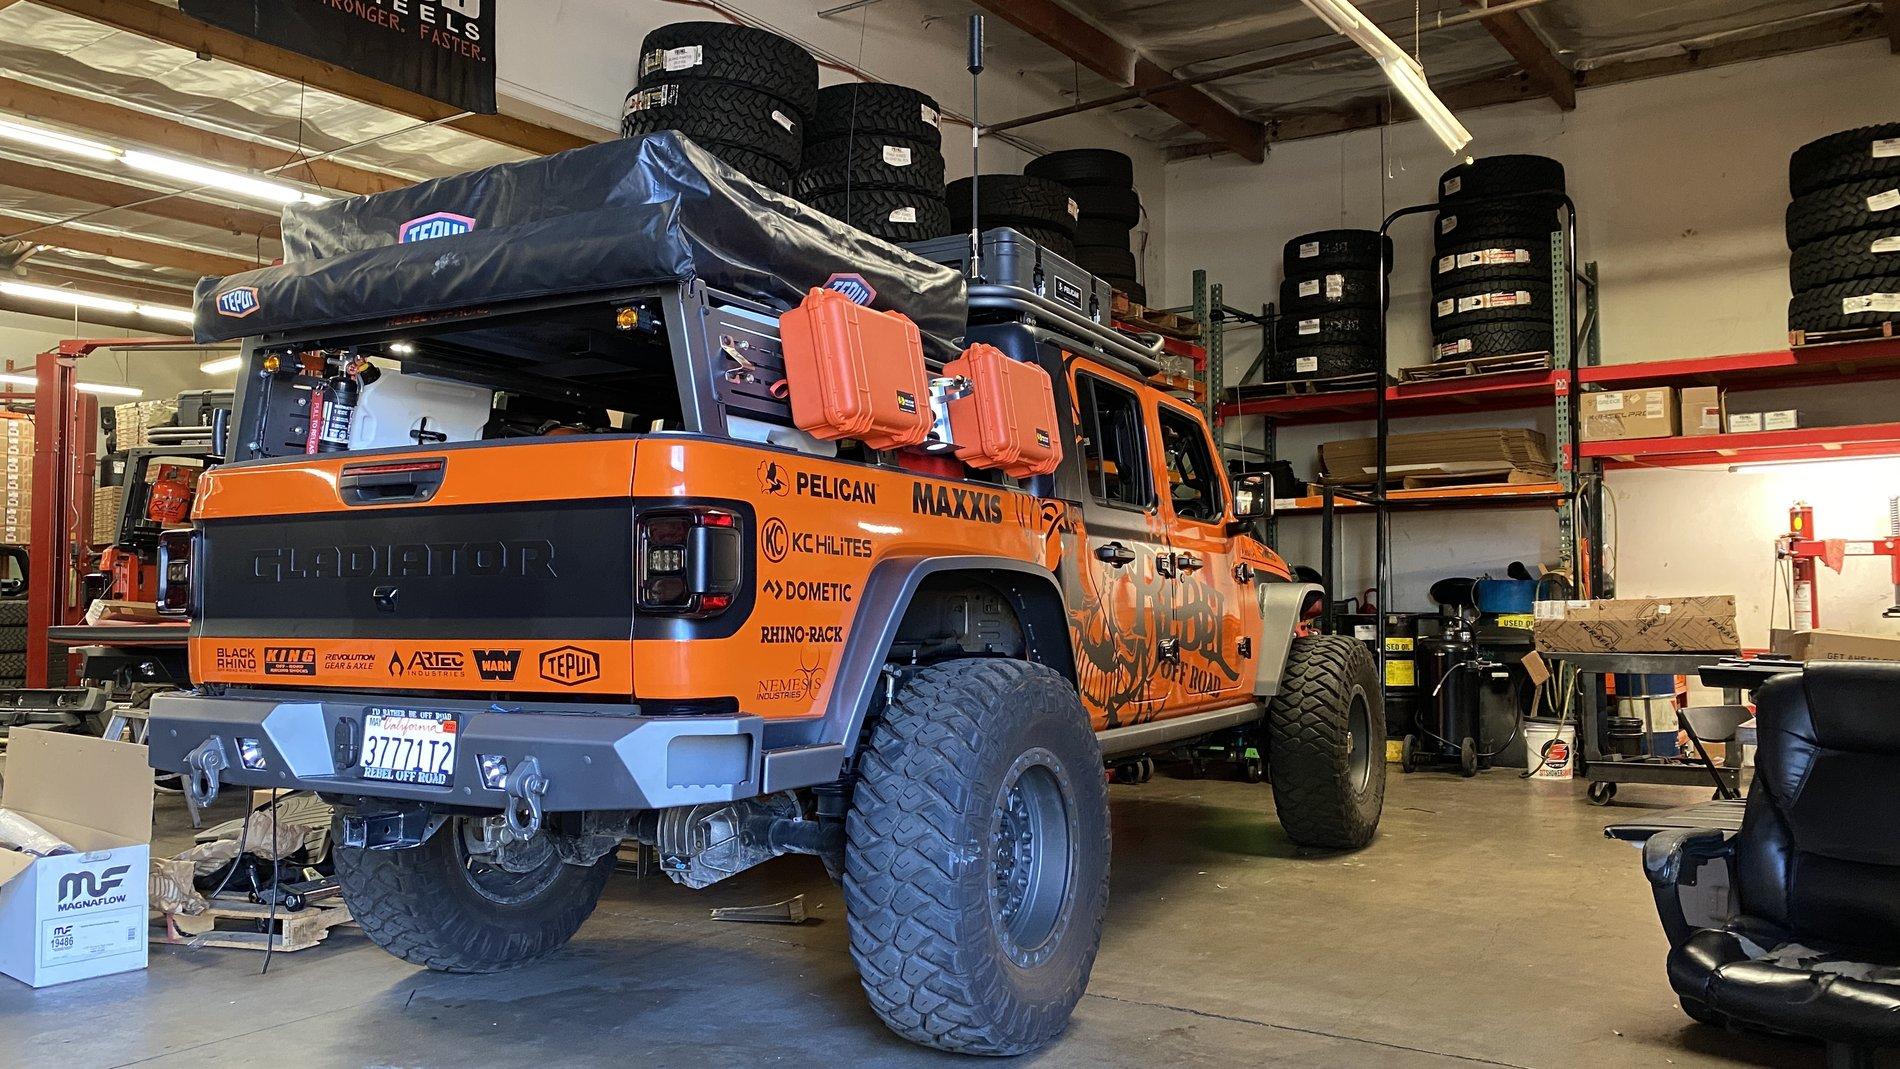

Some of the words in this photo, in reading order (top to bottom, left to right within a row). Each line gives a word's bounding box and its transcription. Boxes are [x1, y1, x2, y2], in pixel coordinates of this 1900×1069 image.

[376, 0, 480, 41] EELS
[420, 24, 486, 62] FASTER.
[222, 290, 253, 312] TEPUI
[312, 402, 320, 418] PULL
[309, 429, 317, 454] RELEAS
[797, 471, 876, 505] PELICAN
[913, 482, 1003, 524] MAXXIS
[765, 522, 784, 558] KC
[792, 532, 814, 553] KC
[255, 540, 558, 582] GLADIATOR
[786, 580, 852, 602] DOMETIC
[1503, 619, 1523, 627] USED
[761, 626, 843, 644] RHINO-RACK
[217, 648, 256, 658] BLACK
[265, 649, 315, 663] KING
[325, 653, 376, 661] REVOLUTION
[407, 651, 464, 670] ARTEC
[1827, 652, 1844, 660] GET
[217, 659, 257, 669] RHINO
[353, 662, 374, 670] AXLE
[482, 660, 511, 672] WARN
[548, 653, 591, 679] TEPUI
[758, 677, 821, 693] NEMESIS
[1160, 662, 1186, 685] OFF
[1189, 665, 1221, 698] ROAD
[756, 691, 801, 701] INDUSTRIES
[419, 711, 433, 719] OFF
[365, 735, 452, 774] 37771T2
[363, 767, 394, 780] REBEL
[395, 770, 416, 782] OFF
[418, 772, 447, 784] ROAD
[58, 894, 127, 912] MAGNAFLOW
[51, 936, 74, 949] 19486
